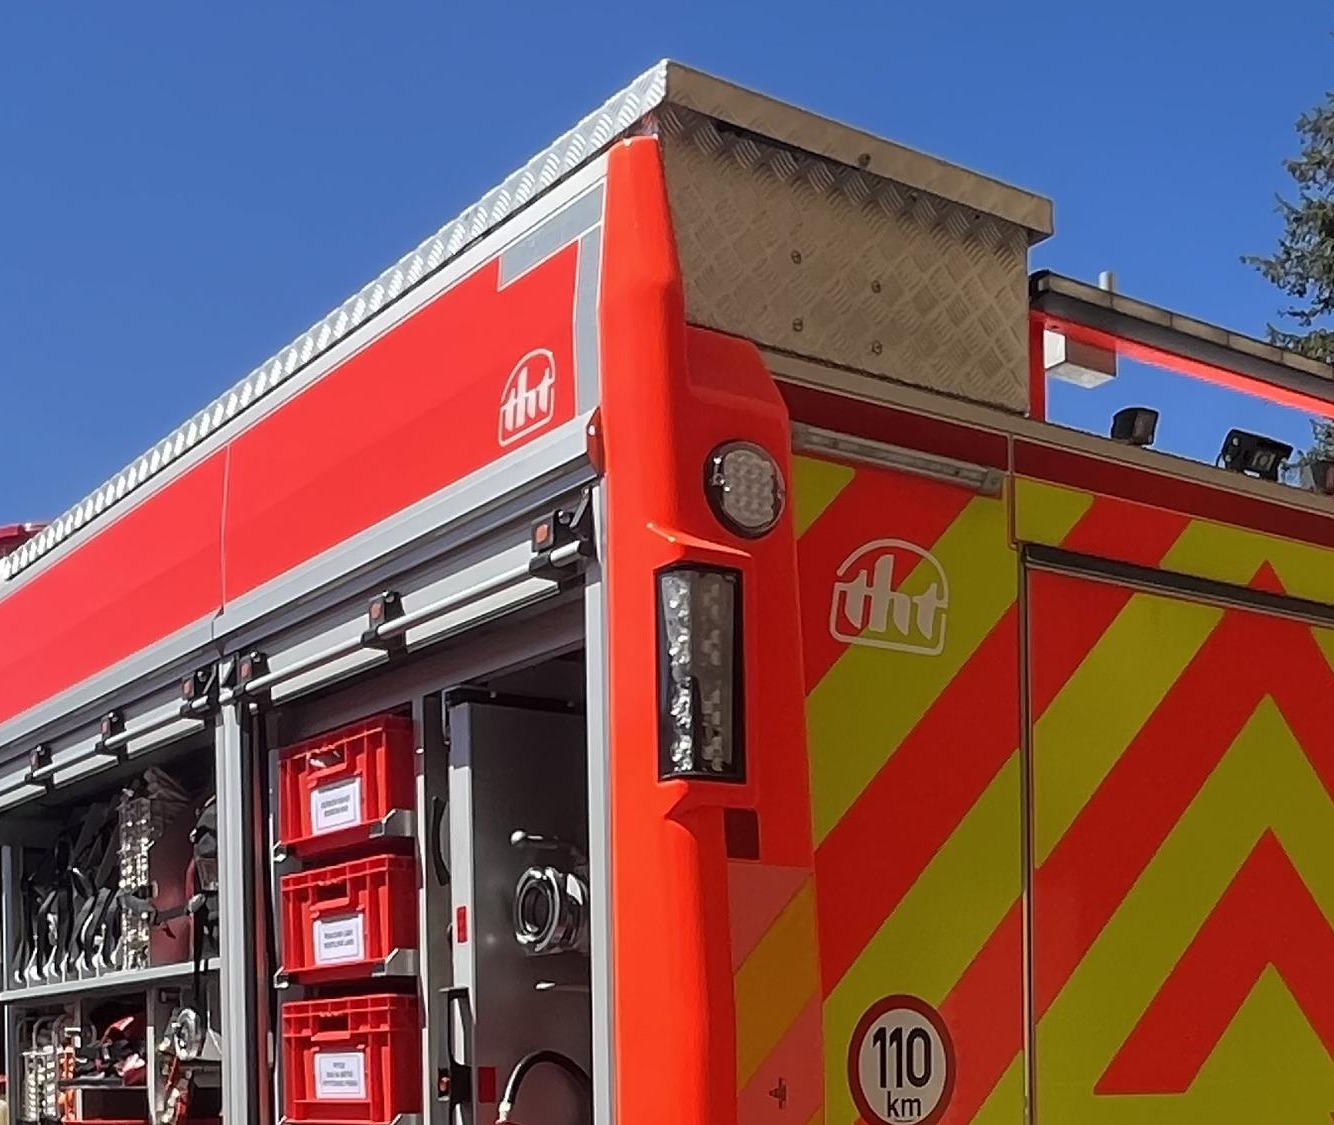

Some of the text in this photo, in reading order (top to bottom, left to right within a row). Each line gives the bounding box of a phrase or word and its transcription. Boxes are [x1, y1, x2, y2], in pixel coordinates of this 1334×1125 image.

[833, 553, 948, 641] tht
[872, 1026, 932, 1089] 110
[886, 1090, 922, 1118] km
